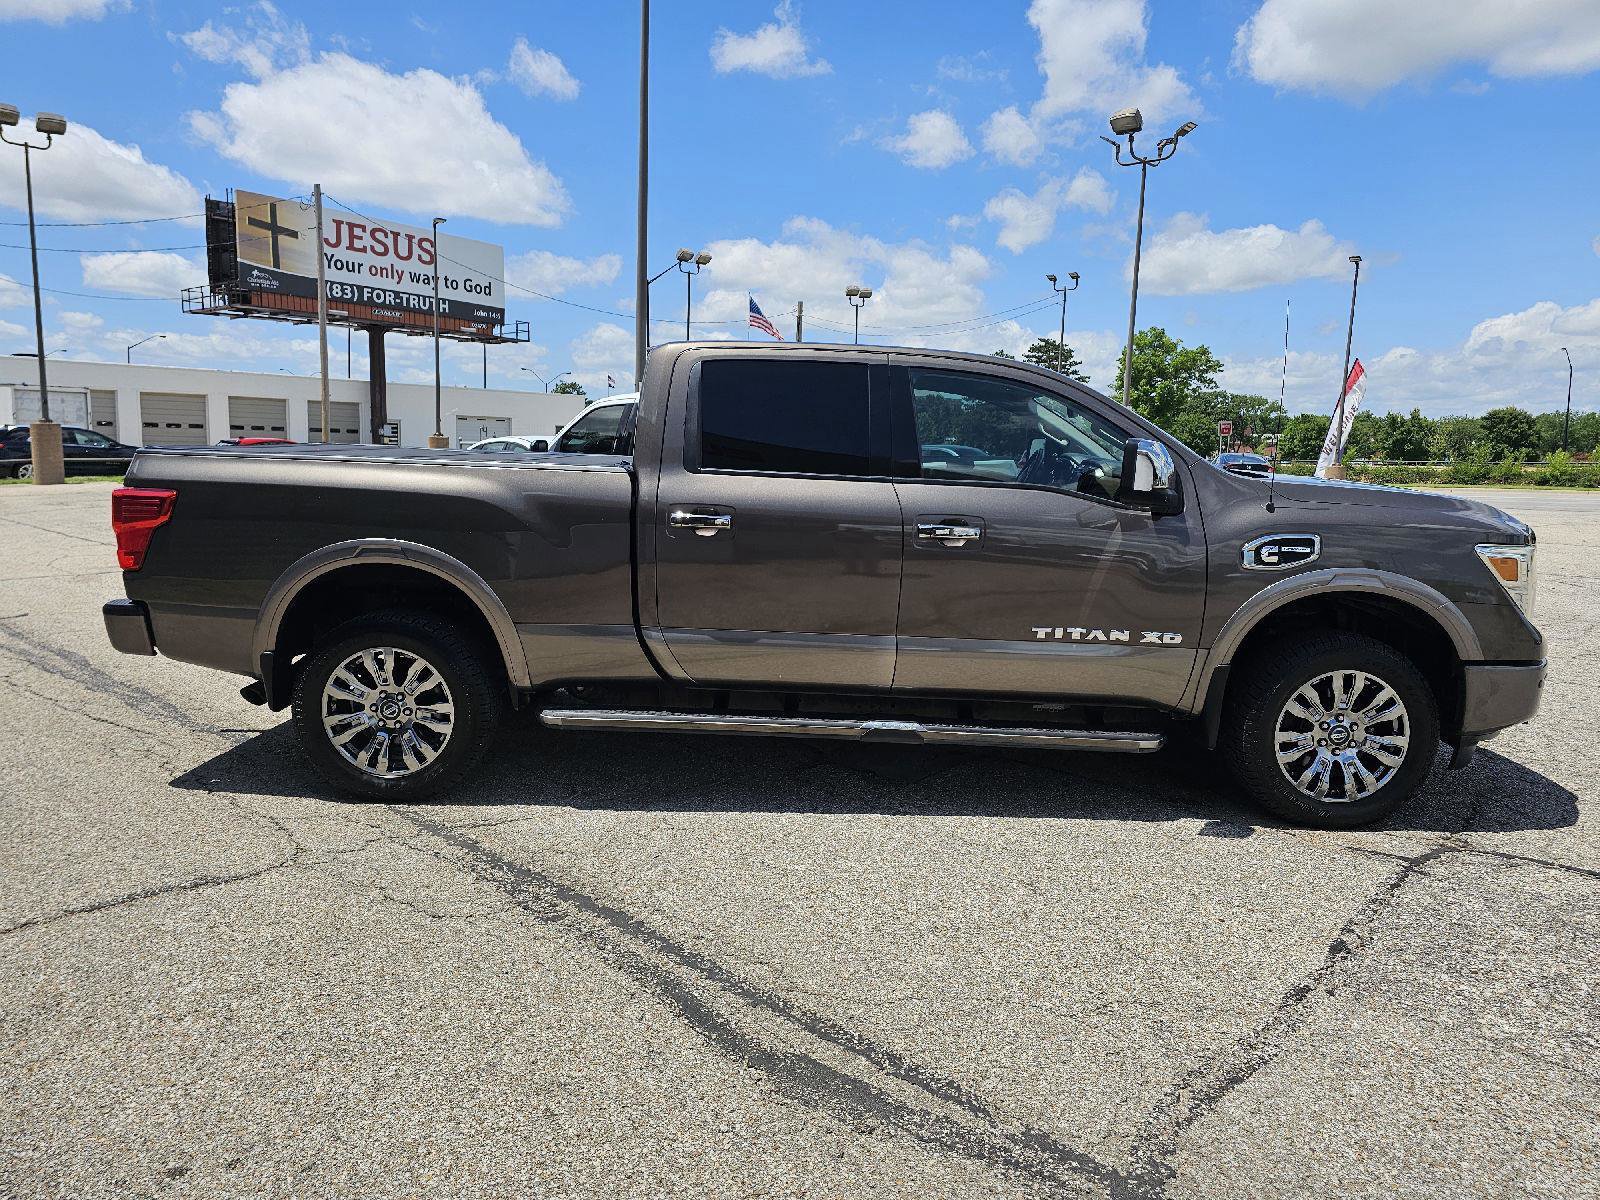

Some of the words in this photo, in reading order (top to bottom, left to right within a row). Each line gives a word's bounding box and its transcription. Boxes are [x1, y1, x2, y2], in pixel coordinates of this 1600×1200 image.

[323, 218, 436, 265] JESUS
[324, 252, 364, 275] Your
[368, 263, 405, 285] only
[408, 271, 440, 291] way
[443, 275, 459, 291] to
[463, 278, 492, 297] God
[326, 281, 358, 302] (83)
[363, 287, 449, 313] FOR-TRUTH
[474, 309, 488, 317] John
[1322, 404, 1359, 456] WELOME
[1031, 627, 1131, 642] TITAN
[1139, 631, 1184, 644] XD
